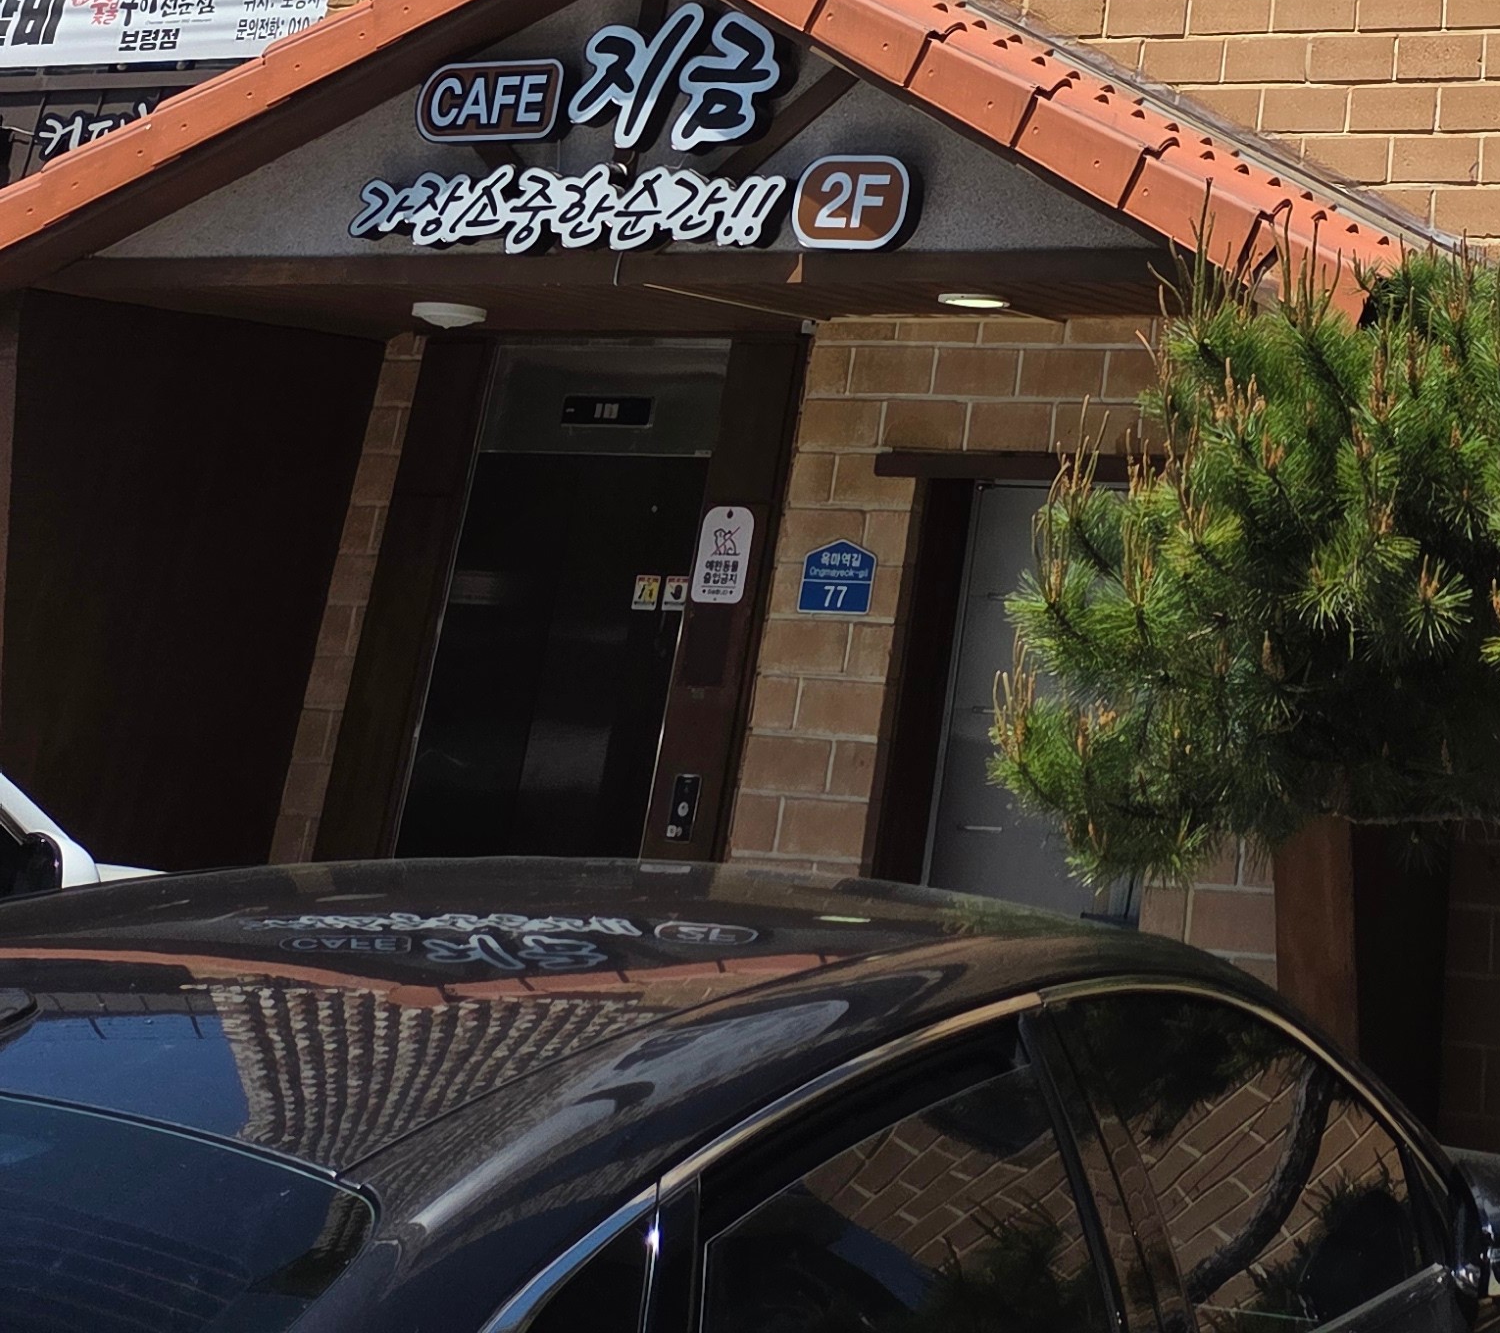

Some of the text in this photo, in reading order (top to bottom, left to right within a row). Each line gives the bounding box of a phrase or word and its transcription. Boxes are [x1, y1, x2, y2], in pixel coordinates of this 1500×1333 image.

[118, 27, 181, 52] 보령점
[430, 2, 782, 151] CAFE 지금
[813, 170, 892, 229] 2F
[823, 585, 848, 609] 77
